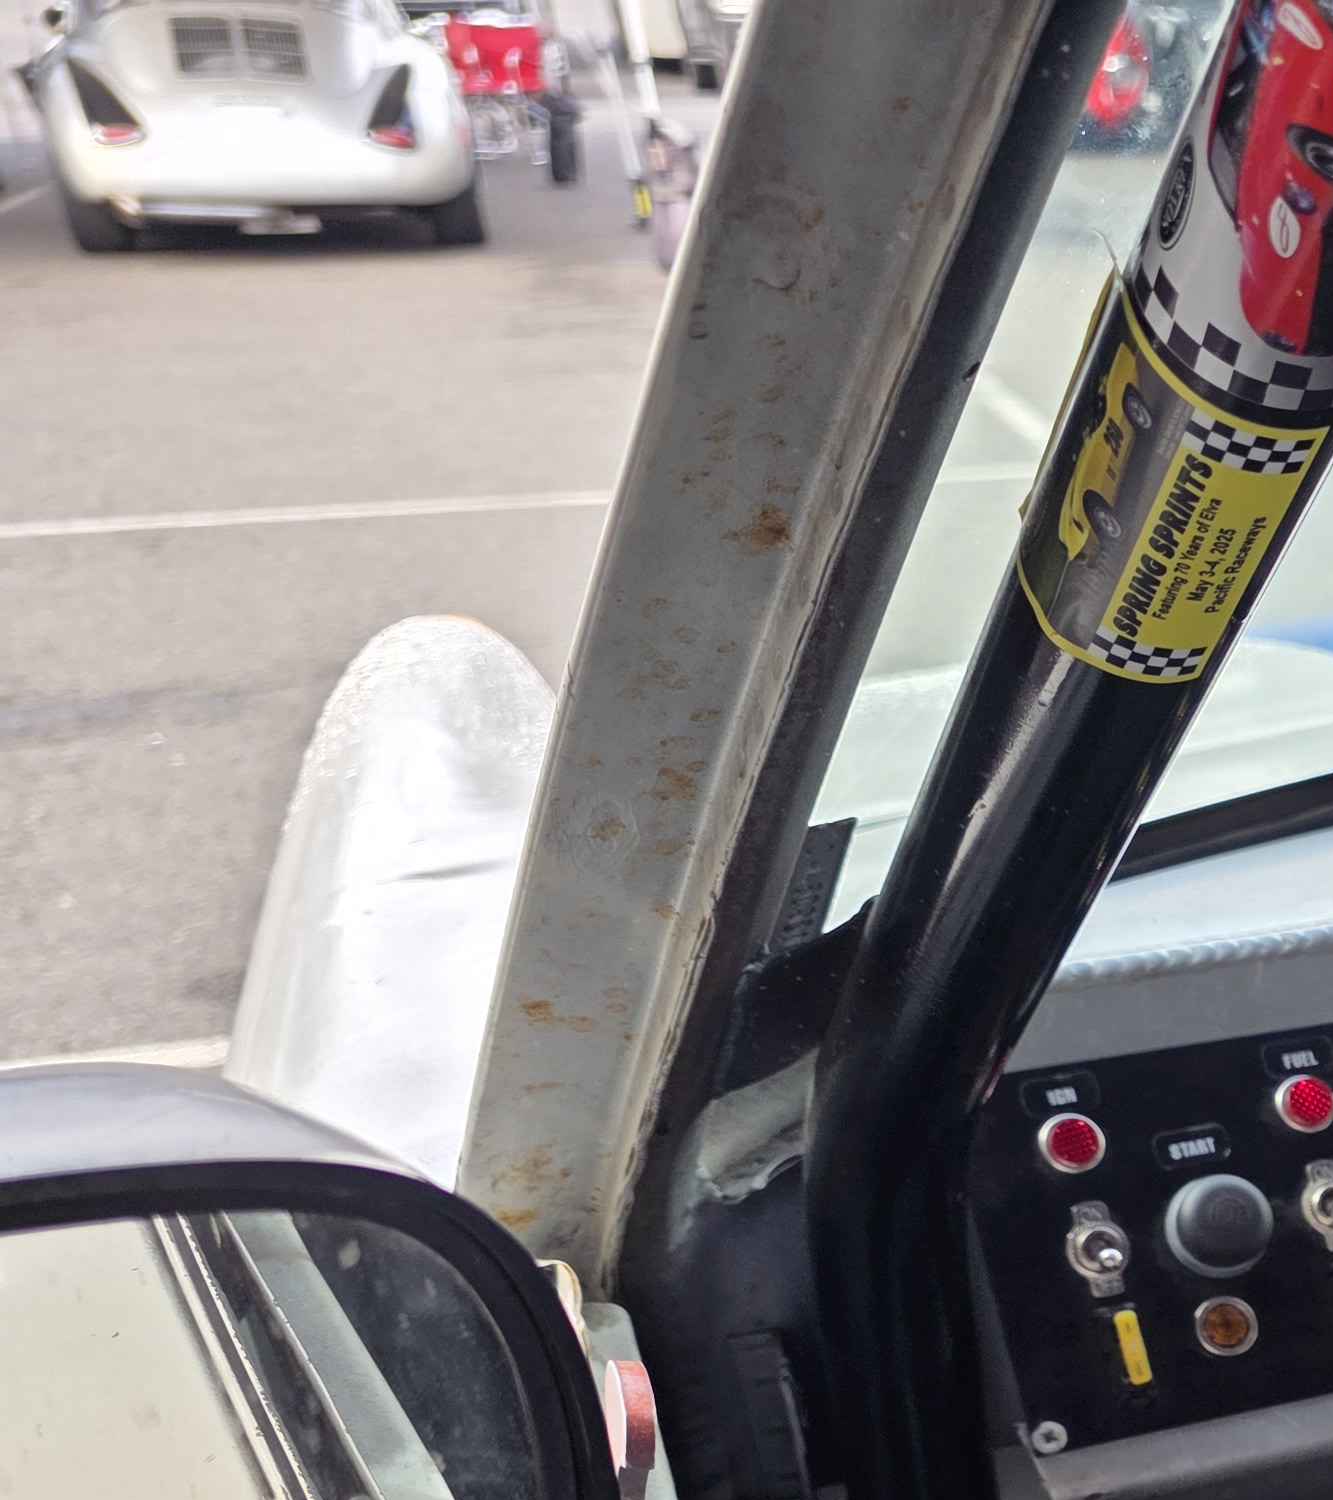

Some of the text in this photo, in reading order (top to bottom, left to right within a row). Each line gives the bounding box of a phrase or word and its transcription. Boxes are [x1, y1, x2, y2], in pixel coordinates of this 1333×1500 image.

[1200, 498, 1222, 524] Elva
[1113, 454, 1213, 637] SPRING SPRINTS
[1179, 533, 1205, 563] Years
[1174, 563, 1191, 577] 70
[1187, 528, 1237, 602] May 3-4, 2025
[1204, 516, 1267, 614] Pacific Raceways
[1153, 575, 1188, 621] Featuring
[1282, 1050, 1320, 1070] FUEL
[1045, 1086, 1078, 1107] IGN
[1168, 1136, 1216, 1161] START
